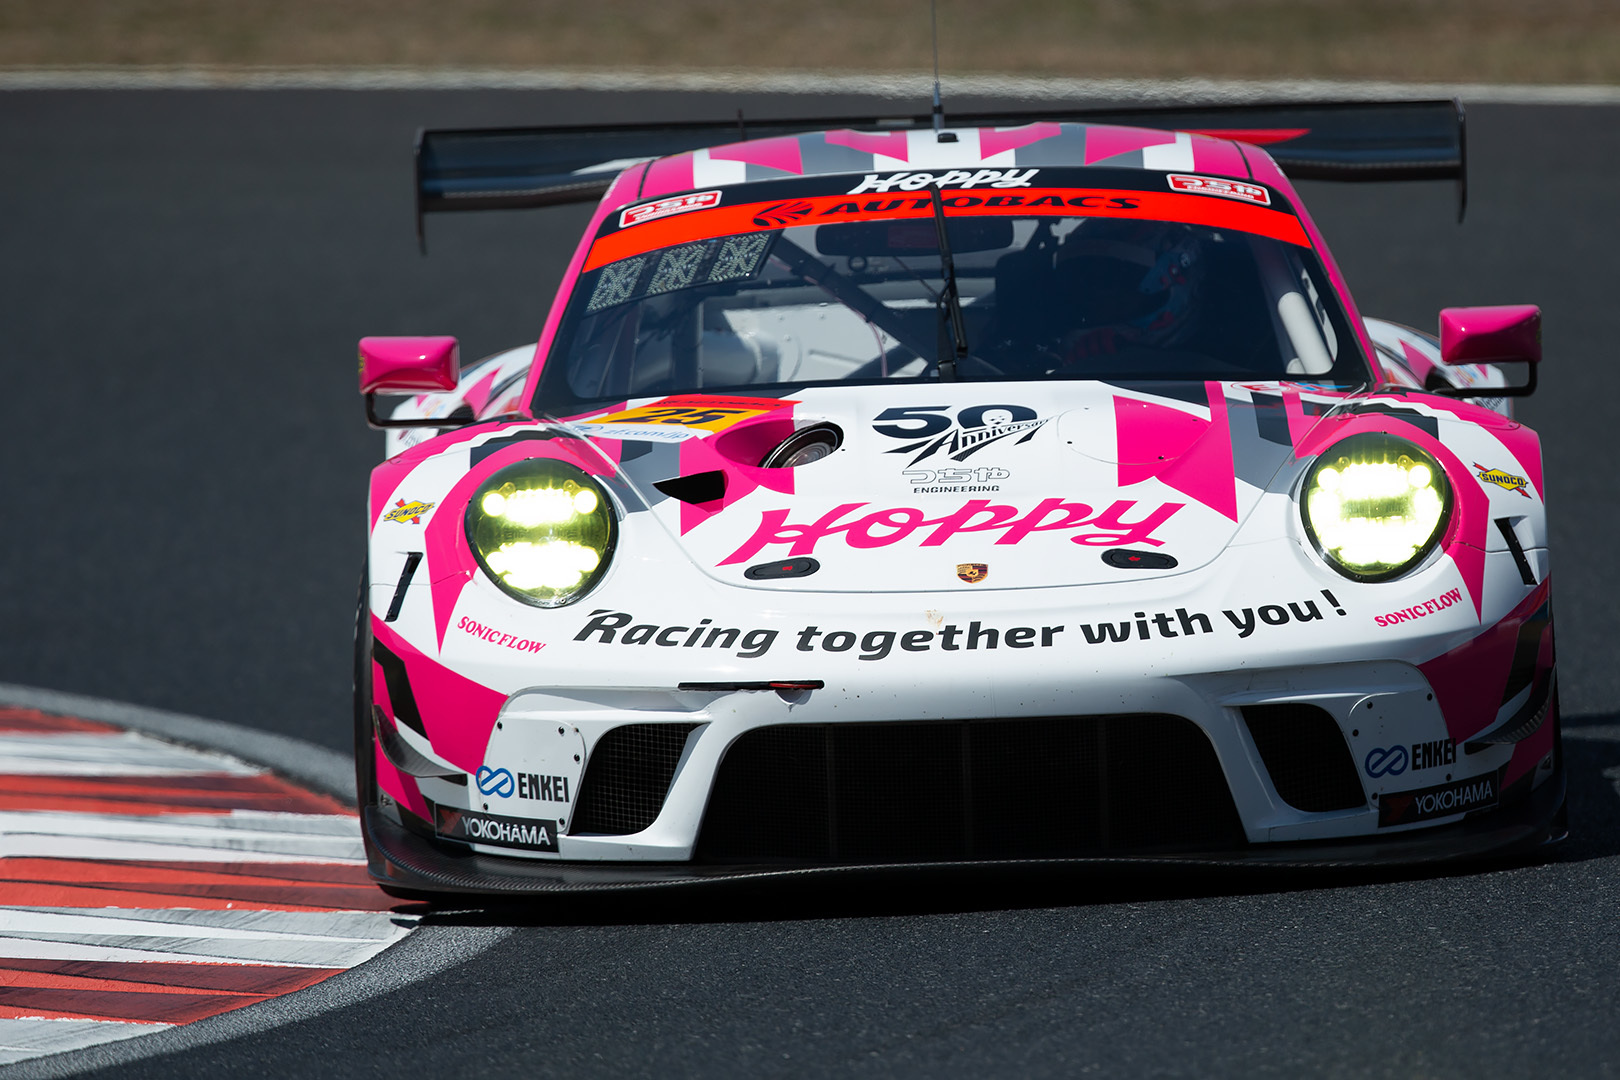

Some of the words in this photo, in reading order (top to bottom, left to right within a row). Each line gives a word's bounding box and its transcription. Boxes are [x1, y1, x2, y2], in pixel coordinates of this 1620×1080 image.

[846, 168, 1041, 195] Hoppy
[819, 196, 1141, 216] AUTOBACS
[607, 408, 749, 425] 25
[872, 404, 1038, 439] 50
[902, 467, 1011, 485] つちや
[913, 485, 1000, 494] ENGINEERING
[1481, 473, 1526, 487] SUNOCO
[385, 503, 432, 520] SUNOCO
[715, 498, 1187, 567] Hoppy
[573, 609, 779, 658] Racing
[796, 621, 1064, 661] together
[1080, 607, 1213, 644] with
[1411, 737, 1457, 771] ENKEI
[517, 772, 570, 803] ENKEI
[1415, 780, 1493, 815] YOKOHAMA
[461, 816, 551, 846] YOKOHAMA
